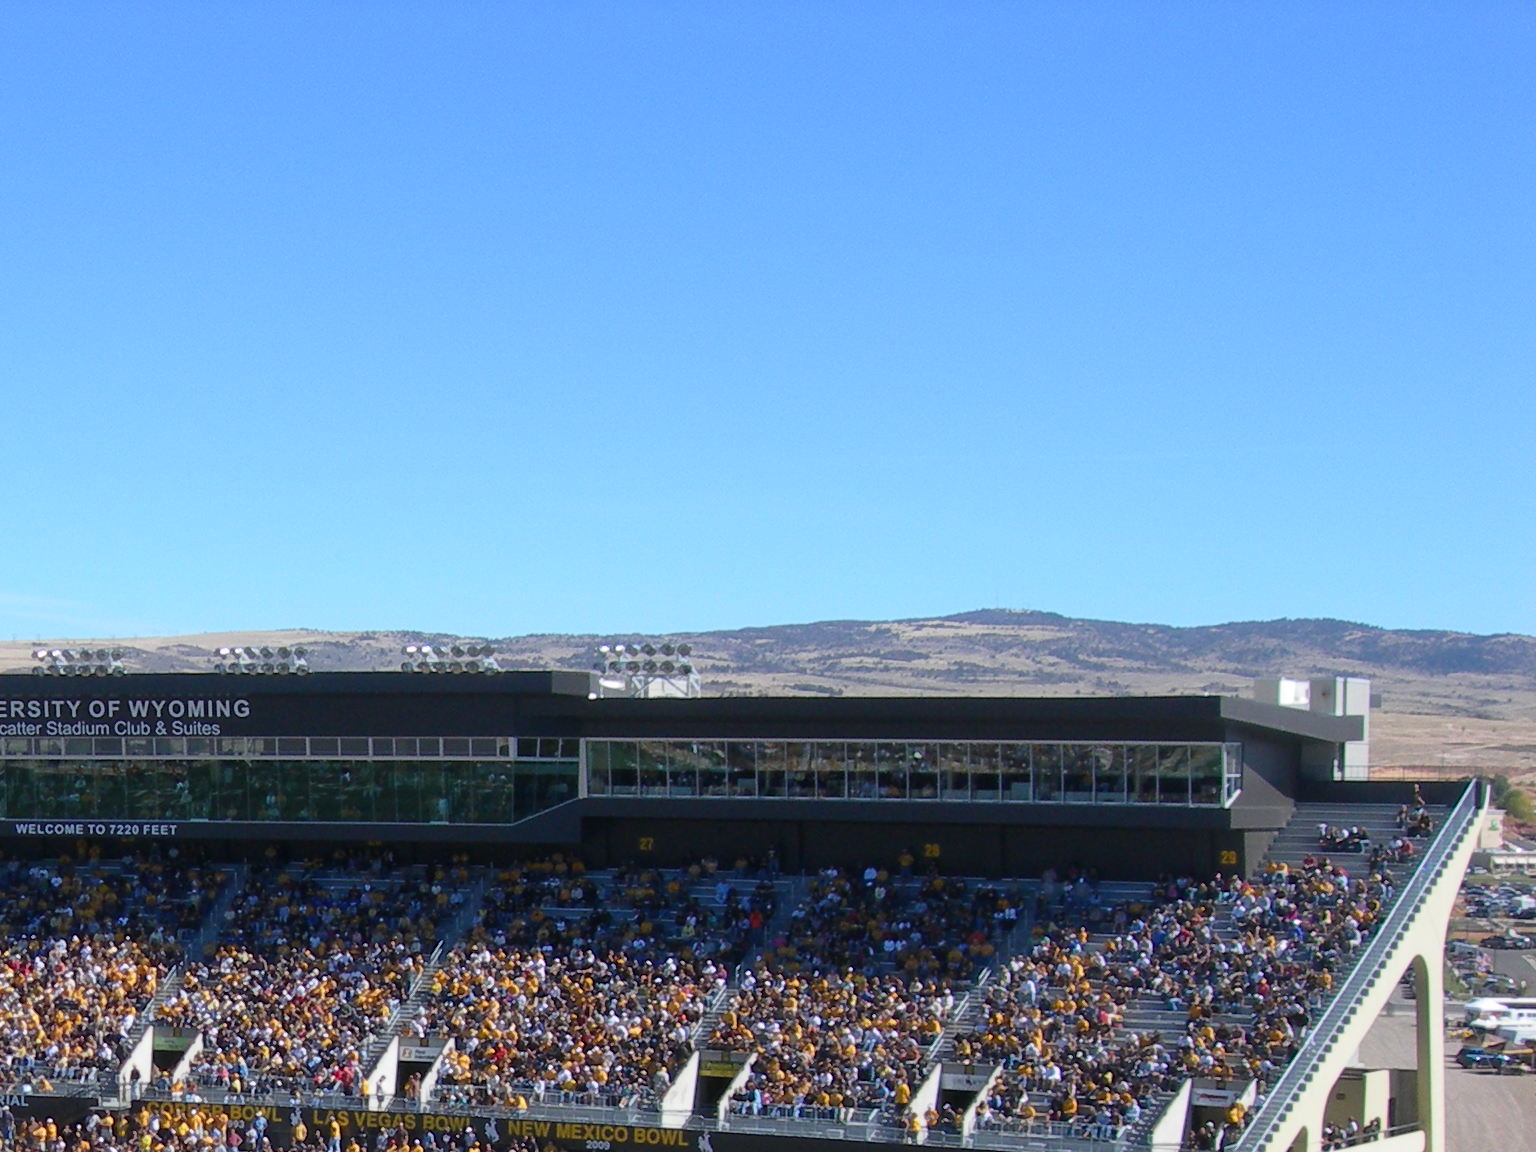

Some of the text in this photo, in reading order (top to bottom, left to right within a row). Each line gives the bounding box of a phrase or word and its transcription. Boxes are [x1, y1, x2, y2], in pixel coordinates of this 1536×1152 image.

[89, 700, 121, 718] OF
[128, 700, 251, 718] WYOMING
[46, 721, 110, 736] Stadium
[114, 721, 151, 736] Club
[155, 721, 167, 736] &
[172, 721, 221, 736] Suites
[15, 823, 178, 836] WELCOME TO 7220 FEET
[354, 1111, 416, 1130] VEGAS
[507, 1119, 689, 1147] NEW MEXICO BOWL
